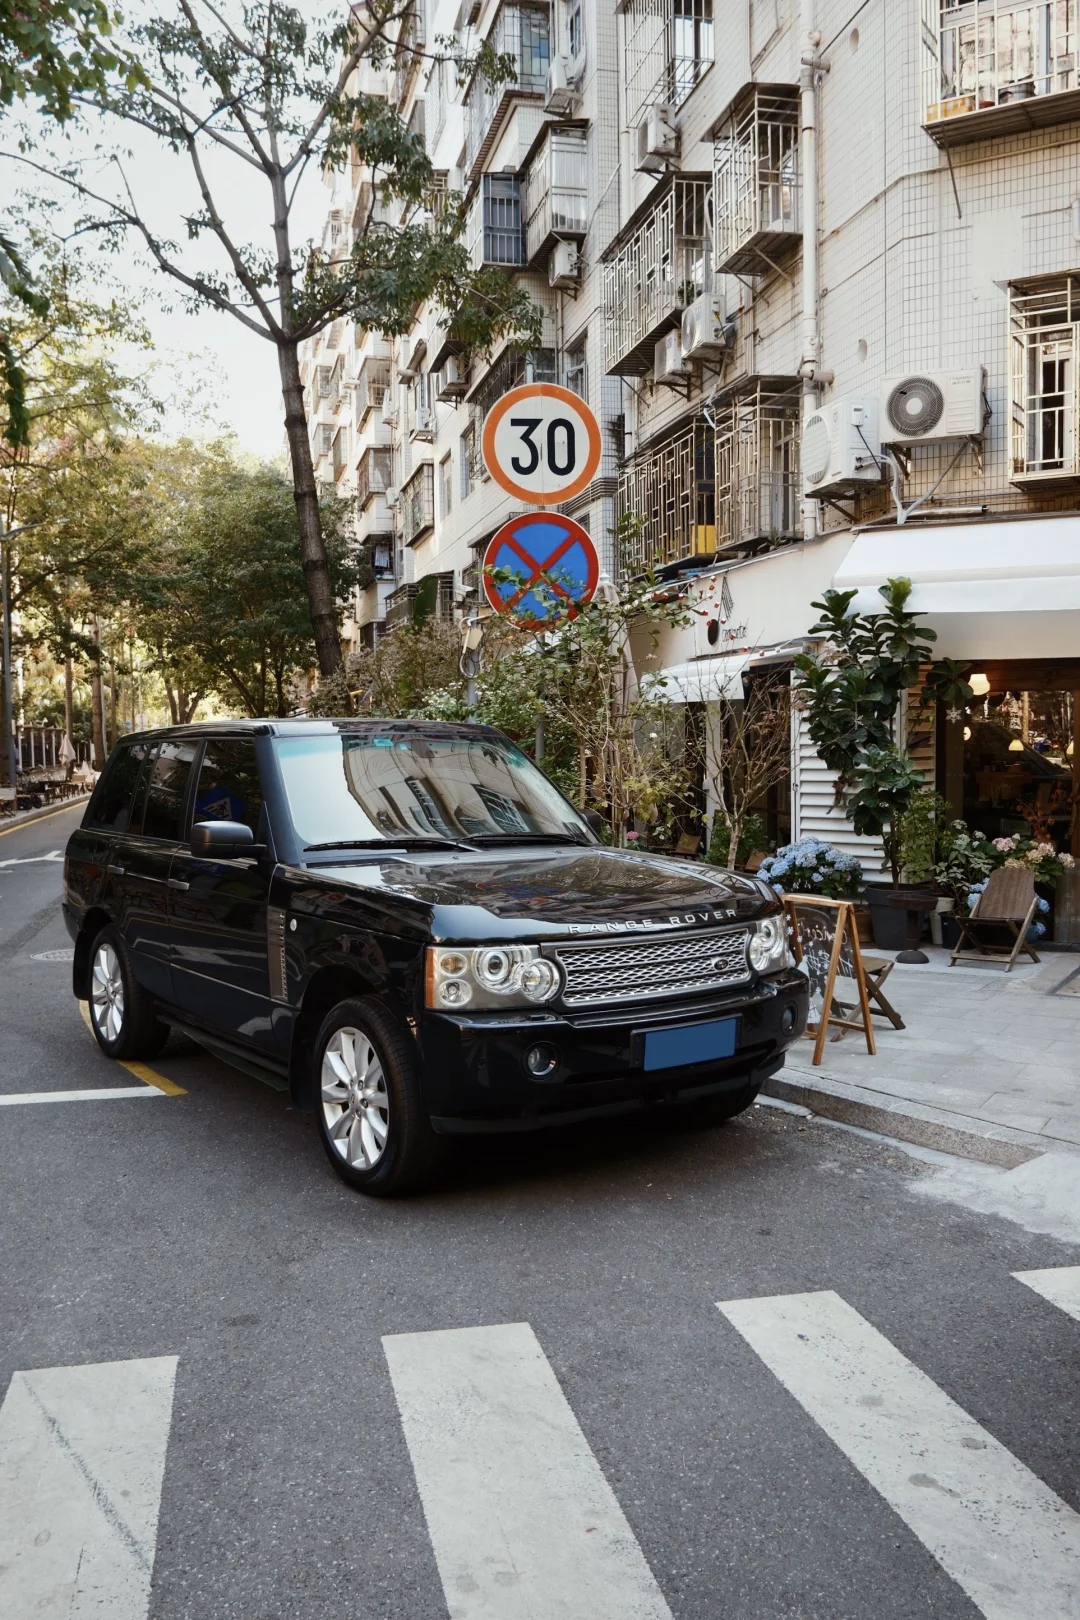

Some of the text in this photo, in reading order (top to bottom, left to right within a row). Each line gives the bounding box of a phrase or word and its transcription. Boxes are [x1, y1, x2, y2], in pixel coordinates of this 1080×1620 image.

[510, 418, 576, 476] 30
[569, 909, 737, 934] RANGE ROVER
